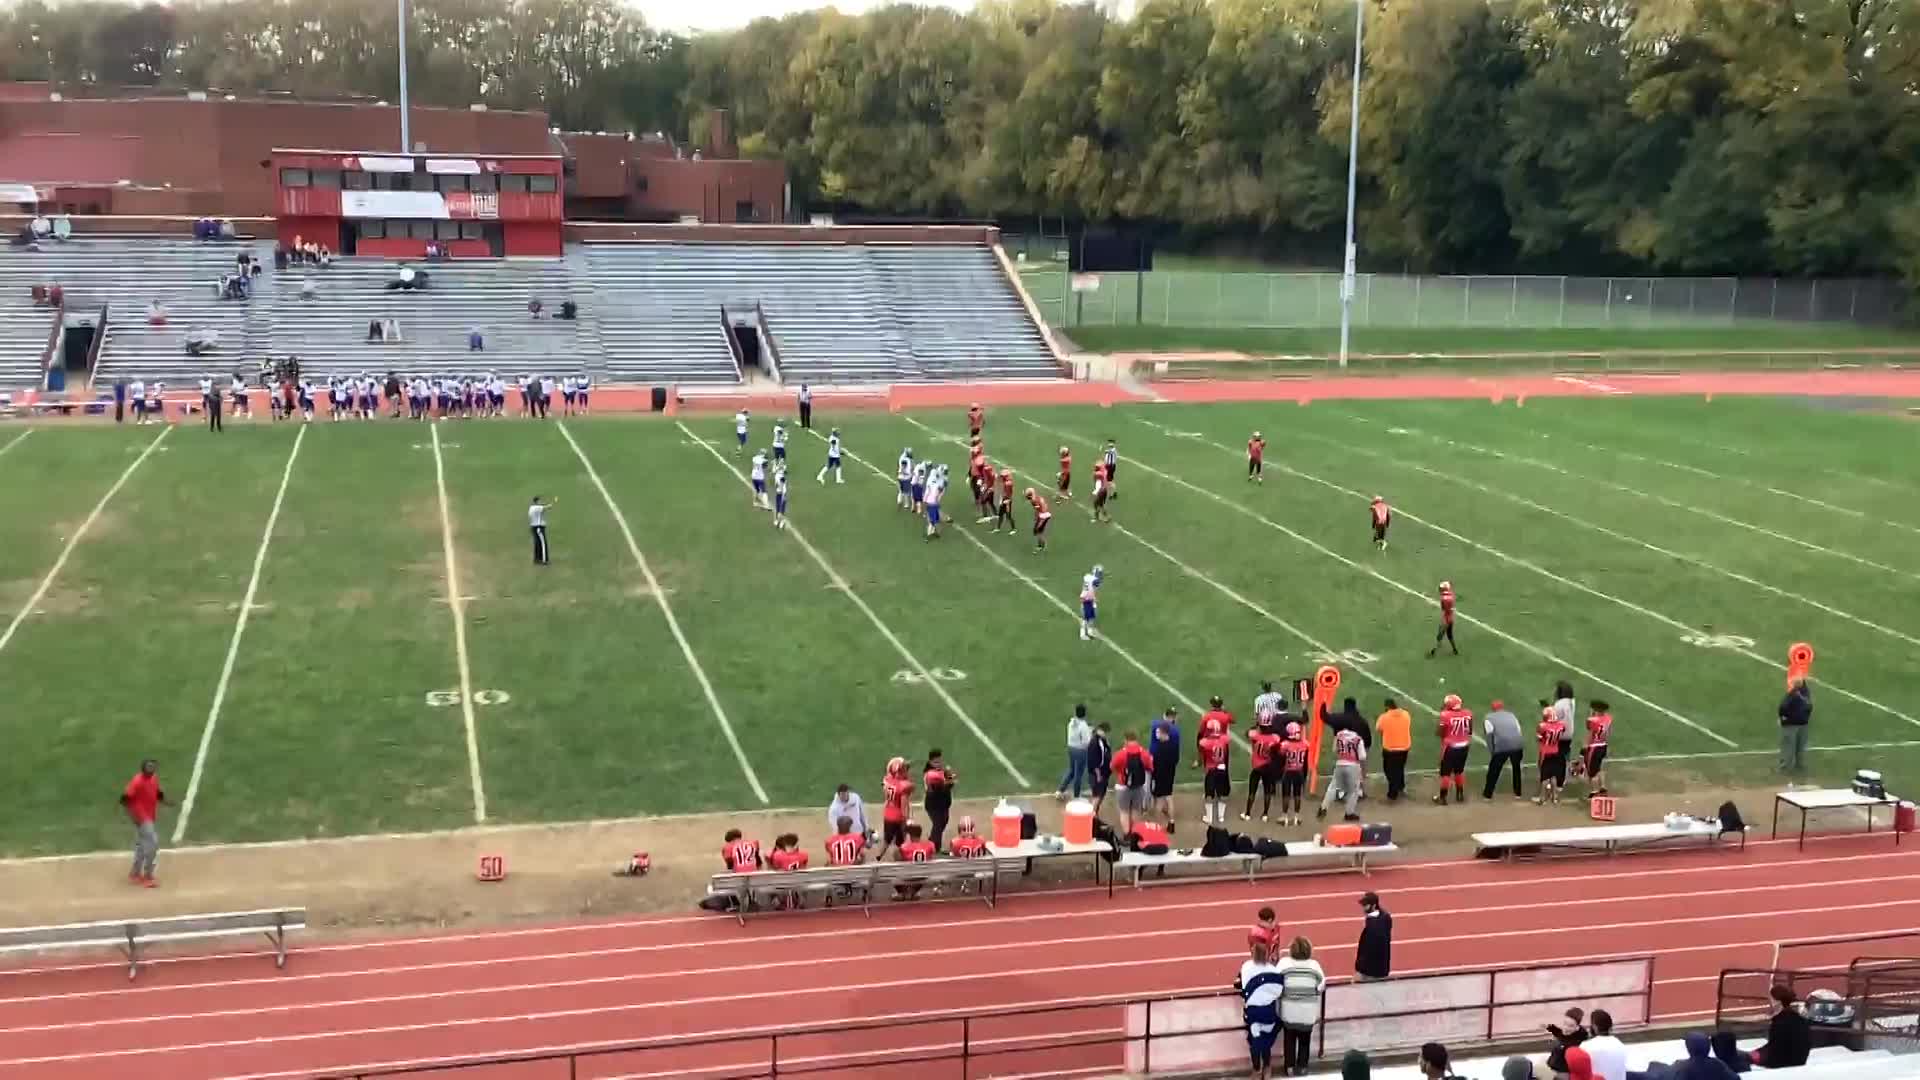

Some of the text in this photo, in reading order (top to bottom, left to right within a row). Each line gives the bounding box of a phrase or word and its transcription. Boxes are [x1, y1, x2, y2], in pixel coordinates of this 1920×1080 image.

[426, 690, 510, 706] 50
[1593, 799, 1613, 816] 30
[481, 856, 502, 877] 50
